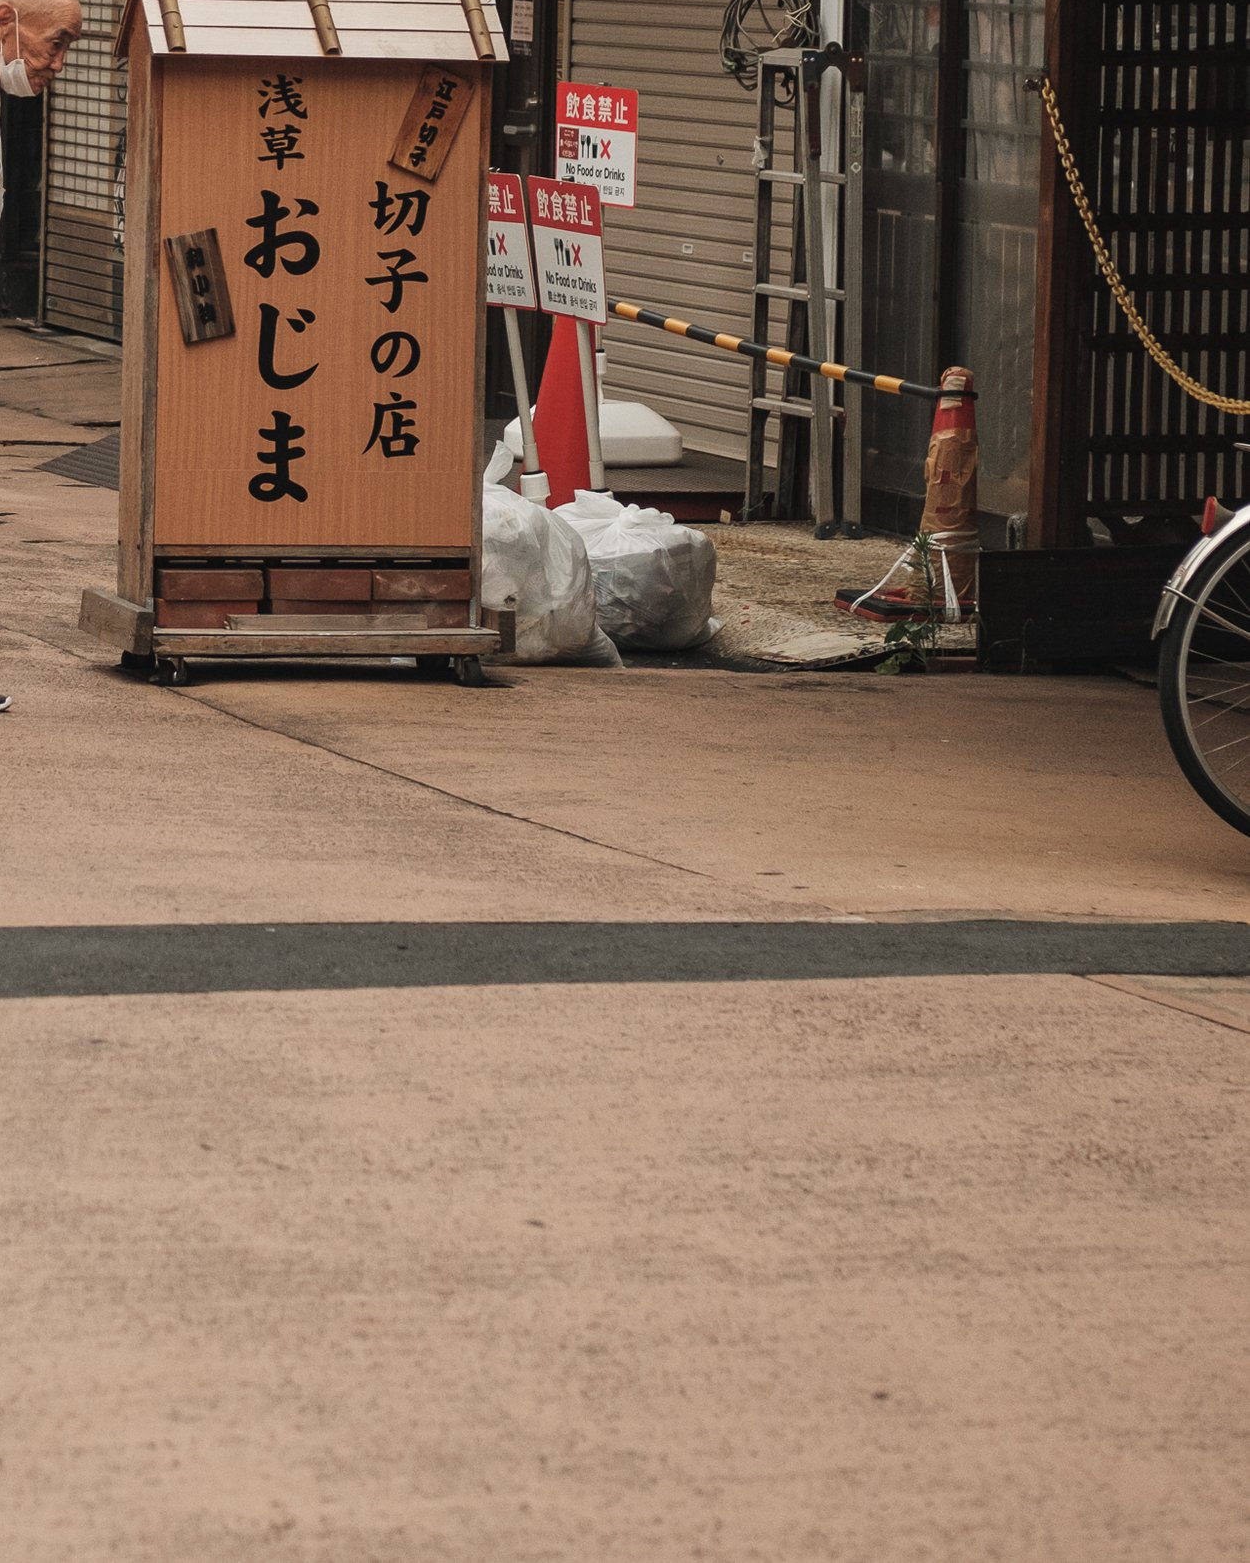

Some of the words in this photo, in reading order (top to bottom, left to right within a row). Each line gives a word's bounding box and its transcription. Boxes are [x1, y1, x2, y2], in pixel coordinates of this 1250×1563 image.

[409, 76, 458, 168] 江戸切子
[565, 91, 629, 126] 飲食禁止
[565, 162, 576, 175] No
[577, 164, 594, 178] Food
[595, 168, 603, 178] or
[604, 167, 626, 182] Drinks
[536, 188, 594, 227] 飲食禁止
[497, 266, 504, 277] or
[504, 264, 524, 280] Drinks
[545, 269, 555, 285] No
[555, 272, 570, 288] Food
[570, 278, 578, 289] or
[578, 277, 597, 294] Drinks
[362, 180, 432, 458] 切子の店
